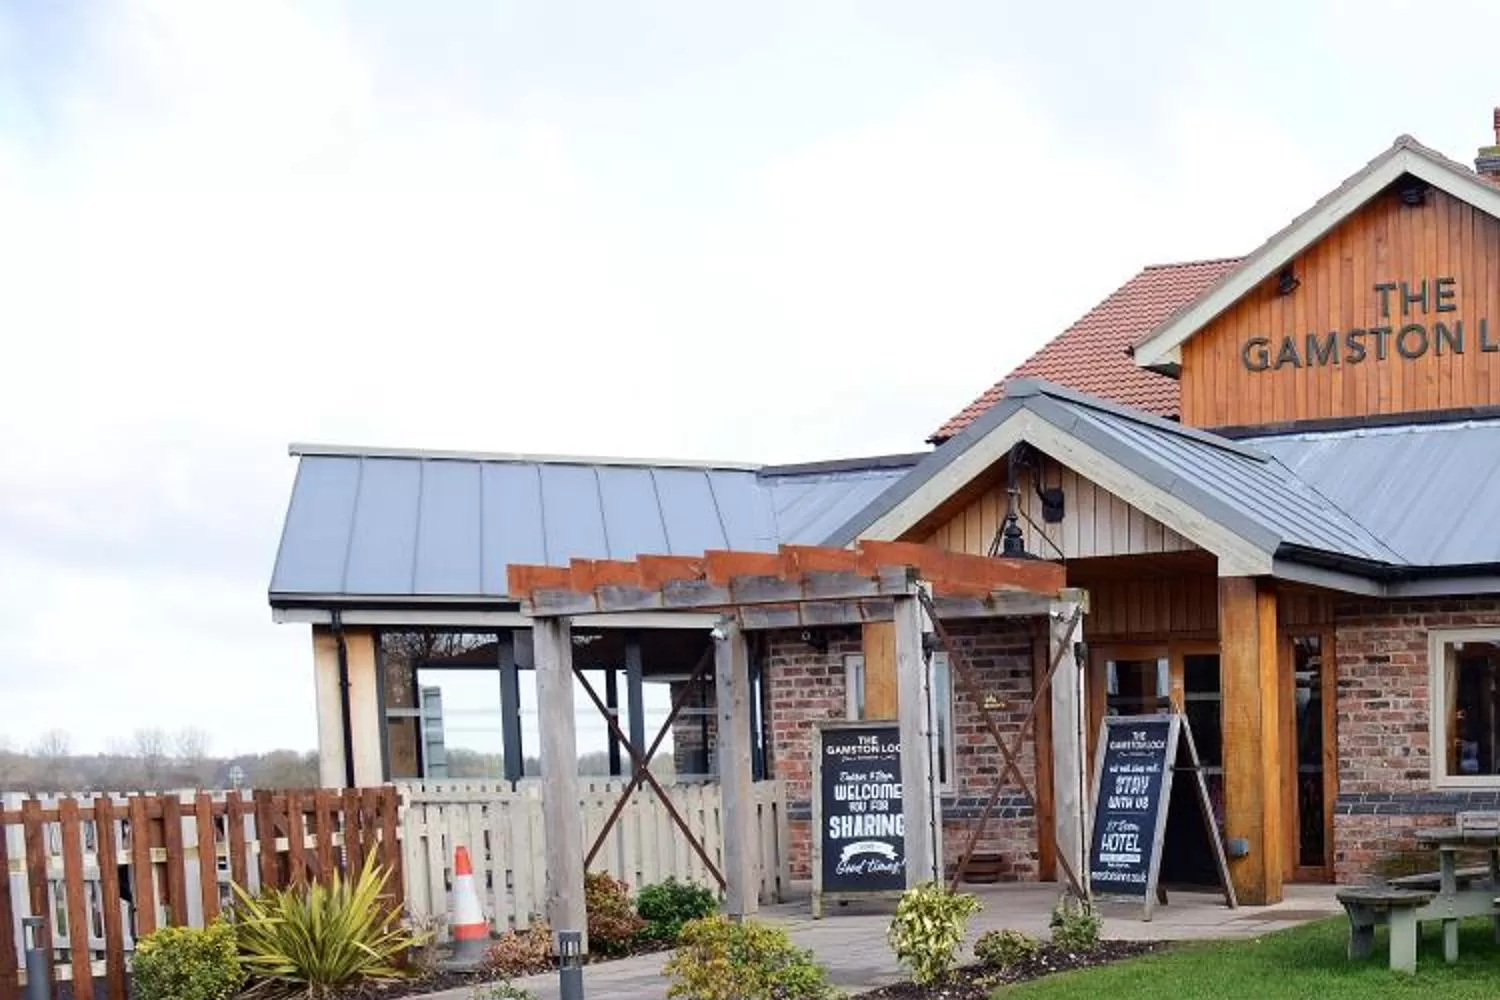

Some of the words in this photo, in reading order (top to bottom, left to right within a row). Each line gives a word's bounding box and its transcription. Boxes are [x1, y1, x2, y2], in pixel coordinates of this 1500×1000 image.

[1374, 277, 1457, 318] THE
[1242, 322, 1465, 372] GAMSTON
[826, 745, 879, 755] GAMSTON
[881, 743, 902, 753] LOC
[857, 735, 878, 745] THE
[834, 783, 903, 800] WELCOME
[1115, 775, 1150, 795] STAY
[849, 801, 867, 812] YOU
[870, 800, 889, 811] FOR
[829, 813, 905, 839] SHARING
[1101, 833, 1142, 853] HOTEL
